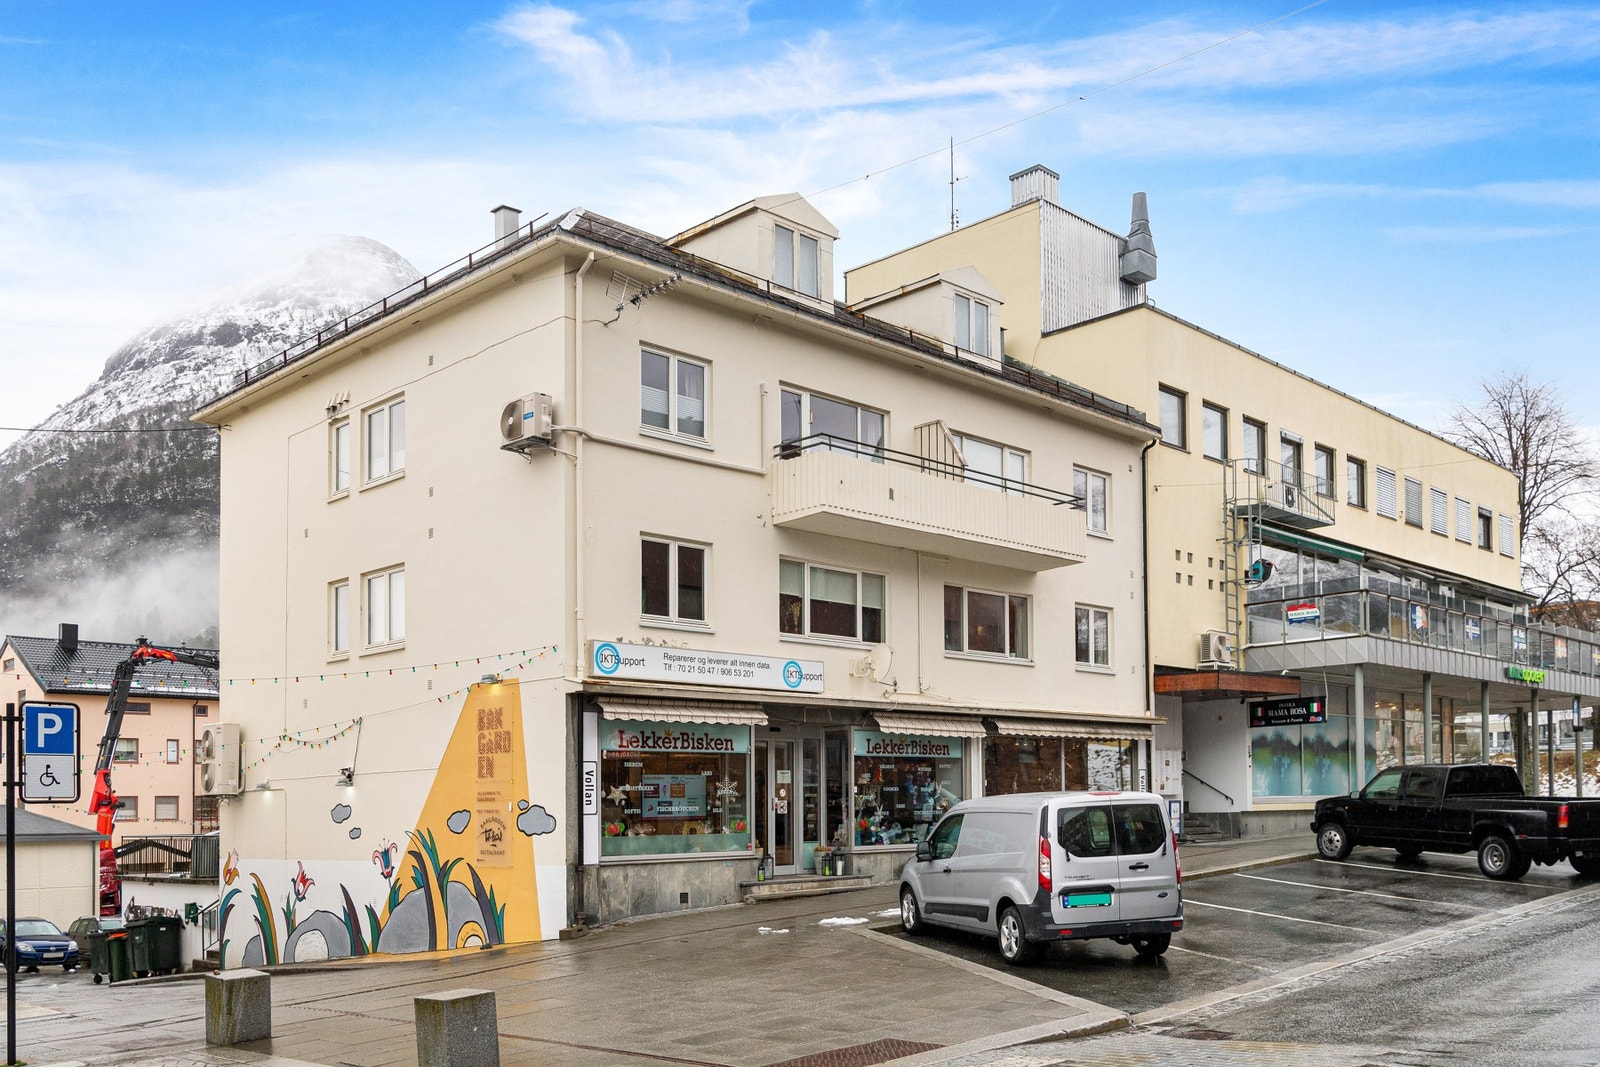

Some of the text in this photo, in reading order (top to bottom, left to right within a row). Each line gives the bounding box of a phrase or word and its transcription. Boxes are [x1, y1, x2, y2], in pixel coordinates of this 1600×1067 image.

[663, 652, 696, 663] Reparerer
[698, 657, 706, 665] og
[707, 656, 729, 666] leverer
[730, 658, 738, 667] alt
[739, 659, 756, 668] innen
[678, 664, 686, 672] 70
[688, 665, 696, 673] 21
[697, 666, 706, 674] 50
[707, 667, 715, 675] 47
[720, 668, 732, 677] 906
[733, 669, 742, 677] 53
[743, 669, 754, 678] 201
[1268, 707, 1307, 717] MAMA ROSA
[37, 712, 63, 748] P
[618, 729, 735, 751] LekkerBisken
[866, 738, 950, 756] LekkerBisken
[584, 770, 595, 806] Vollan
